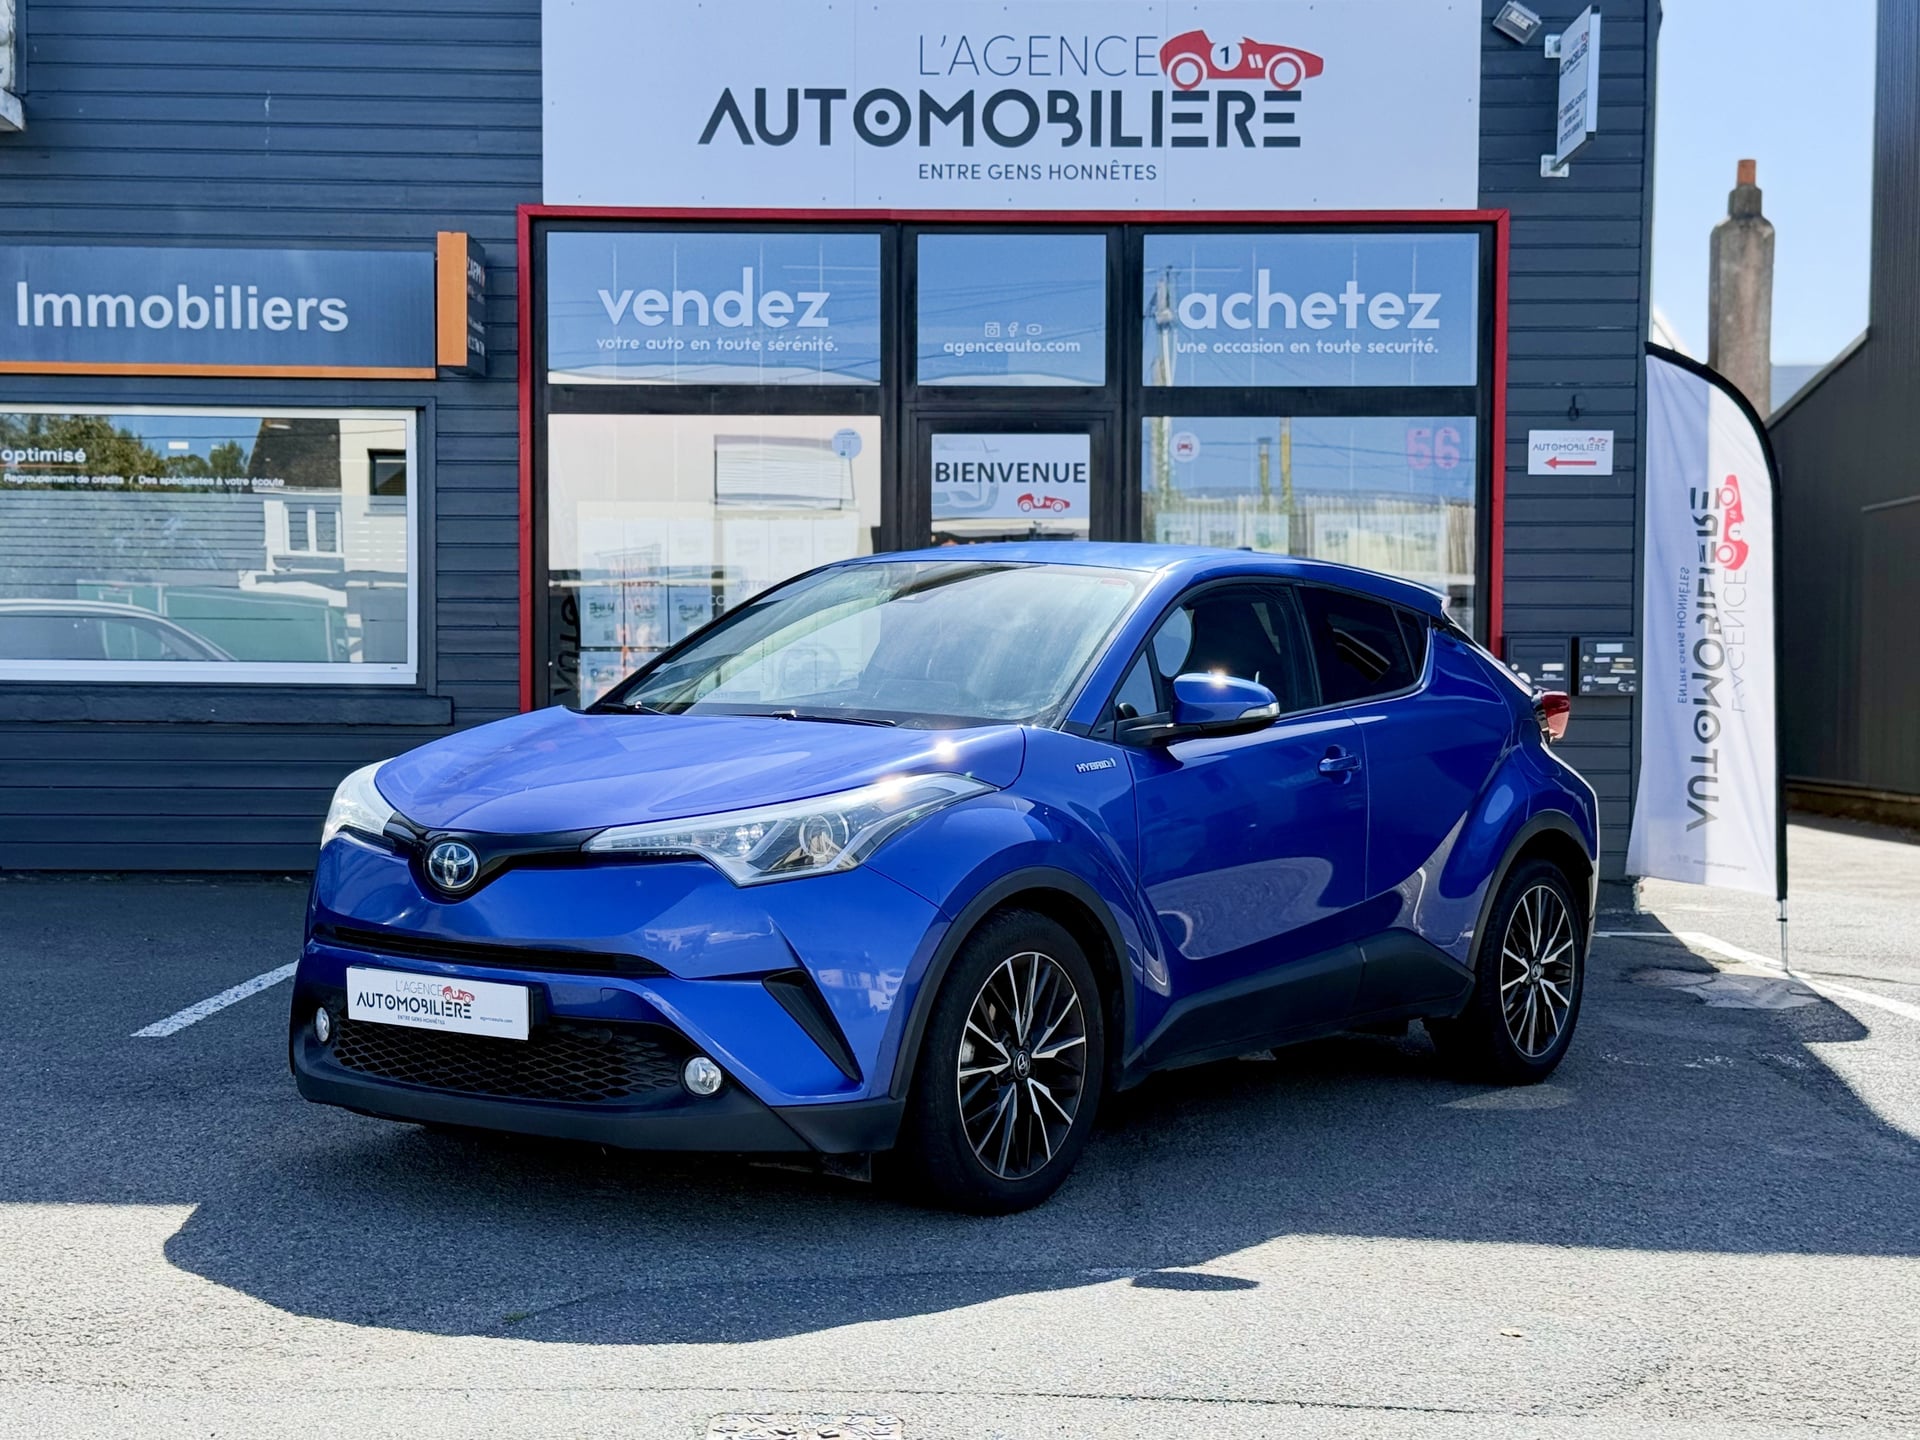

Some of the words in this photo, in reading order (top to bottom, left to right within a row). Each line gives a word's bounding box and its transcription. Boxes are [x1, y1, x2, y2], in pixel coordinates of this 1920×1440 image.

[920, 35, 1159, 77] L'AGENCE
[919, 164, 981, 180] ENTRE
[988, 164, 1041, 180] GENS
[1049, 160, 1157, 181] HONNÊTES
[16, 281, 348, 332] Immobiliers
[598, 267, 830, 327] vendez
[1178, 269, 1441, 329] achetez
[597, 338, 639, 351] votre
[646, 337, 684, 350] auto
[691, 339, 710, 350] en
[717, 337, 762, 351] toute
[768, 336, 839, 352] sérénité.
[944, 340, 1080, 356] agenceauto.com
[1177, 342, 1207, 353] une
[1213, 338, 1283, 353] occasion
[1290, 342, 1309, 353] en
[1316, 339, 1361, 353] toute
[1367, 337, 1439, 353] securité.
[1, 447, 87, 464] optimisé
[1407, 427, 1460, 469] 56
[4, 473, 75, 485] Regroupement
[77, 474, 89, 484] de
[92, 474, 124, 485] crédits
[139, 475, 156, 485] Des
[160, 475, 214, 487] spécialistes
[225, 477, 249, 486] votre
[252, 476, 285, 487] écoute
[935, 462, 1086, 483] BIENVENUE
[395, 979, 443, 997] L'AGENCE
